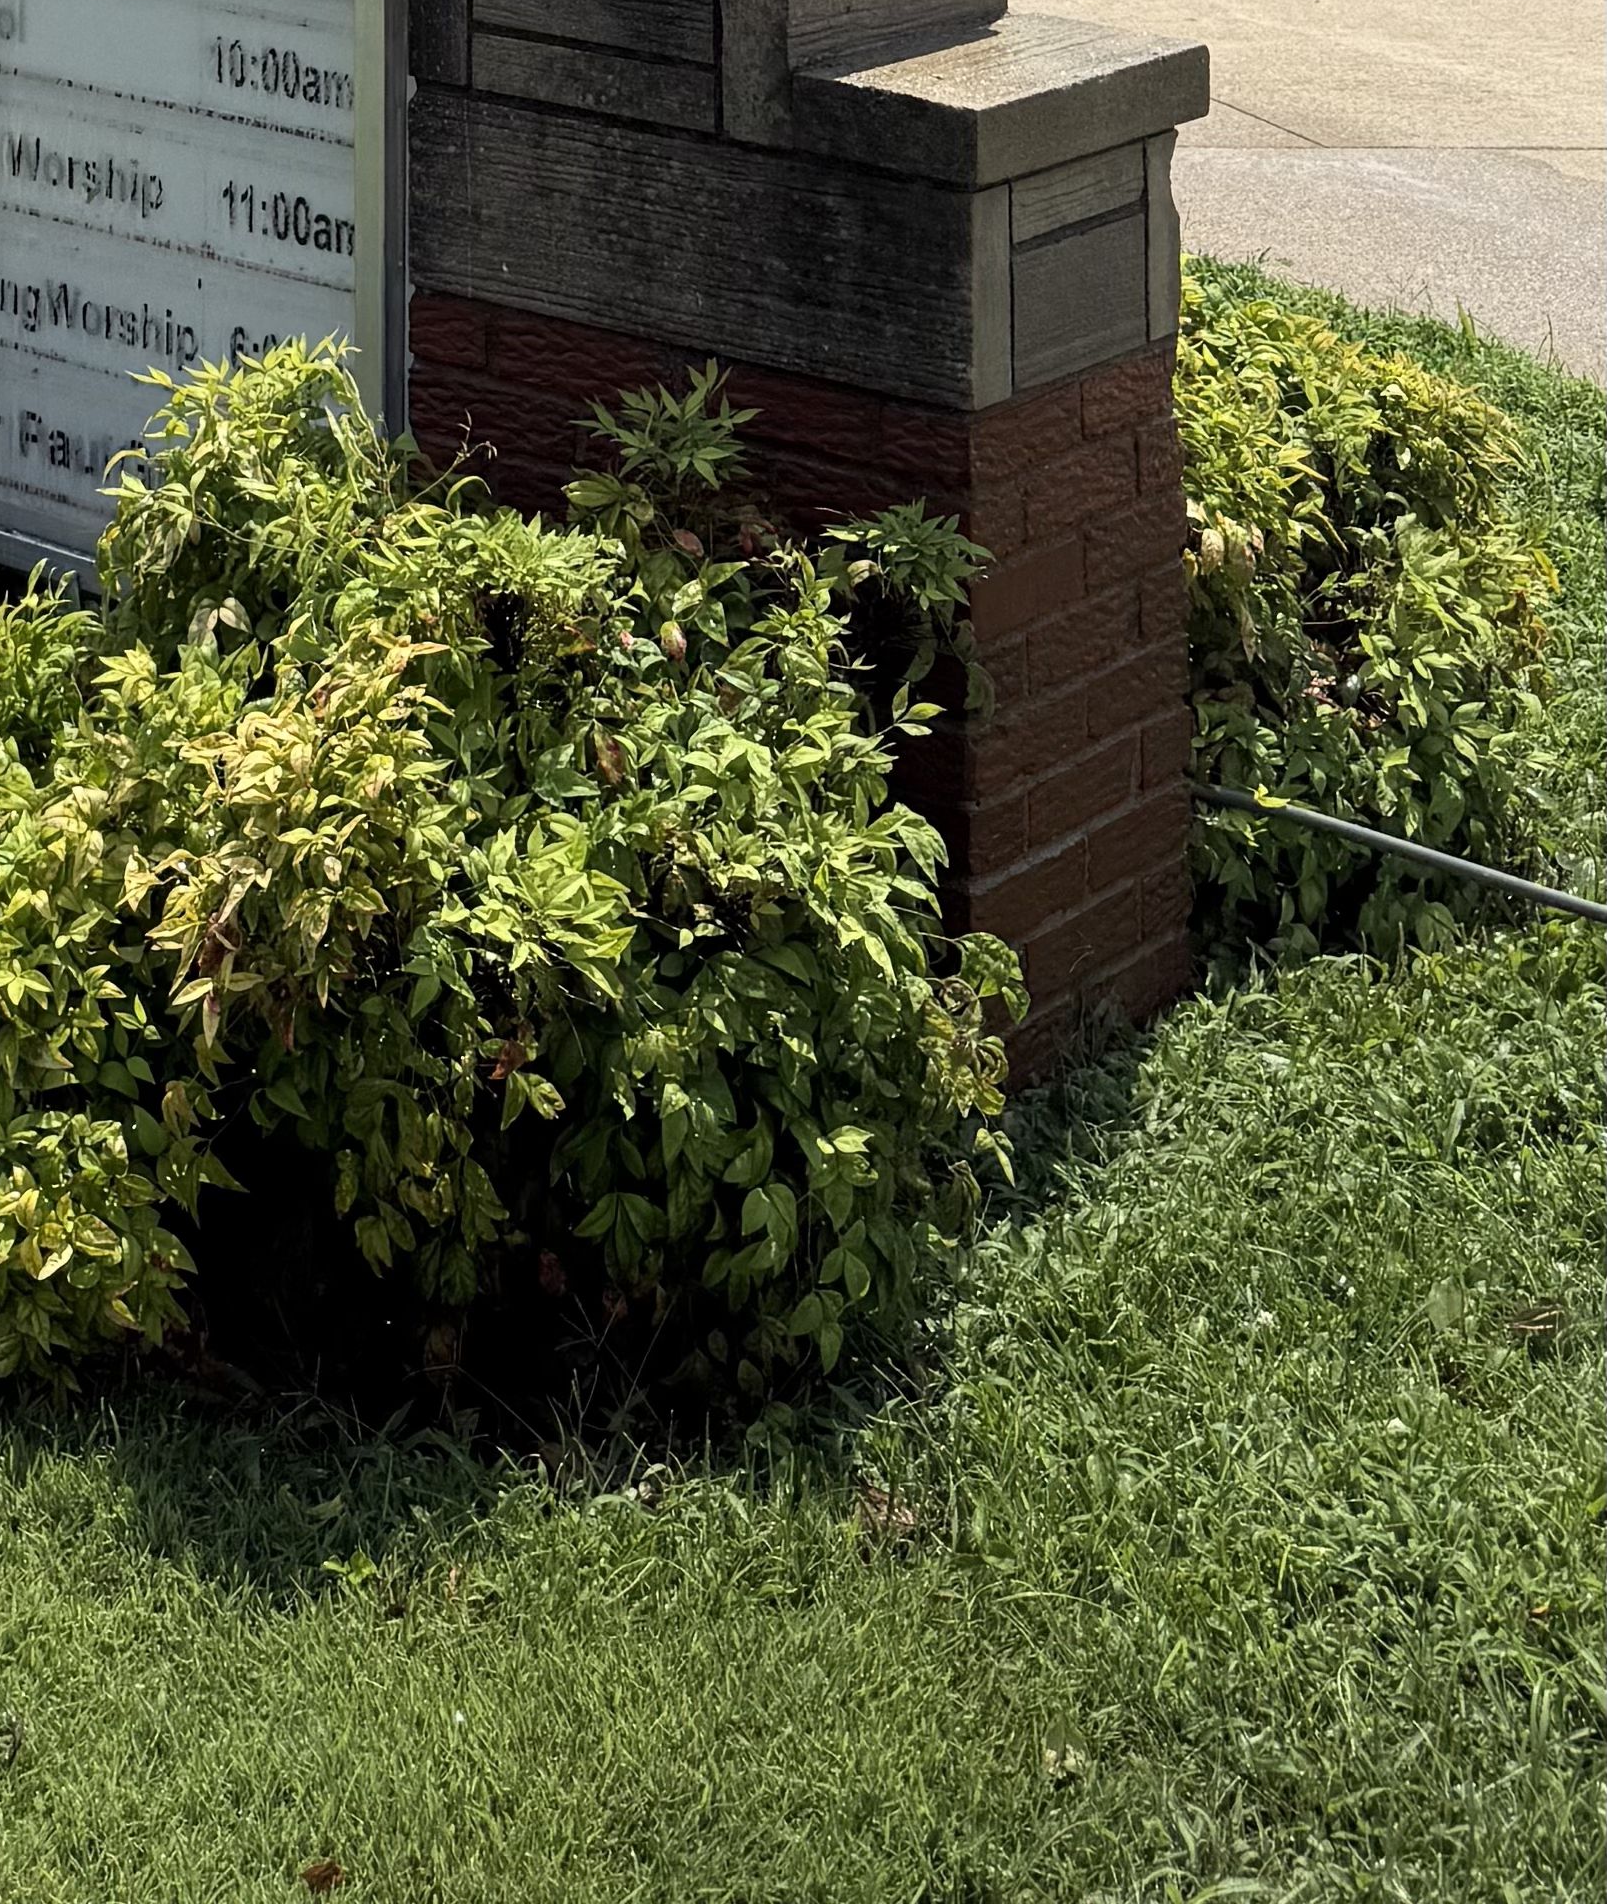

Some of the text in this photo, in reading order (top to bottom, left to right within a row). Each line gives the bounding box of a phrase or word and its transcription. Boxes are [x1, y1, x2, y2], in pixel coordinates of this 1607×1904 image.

[212, 36, 355, 109] 10:00am
[0, 132, 164, 219] Worship
[46, 278, 199, 371] Worship
